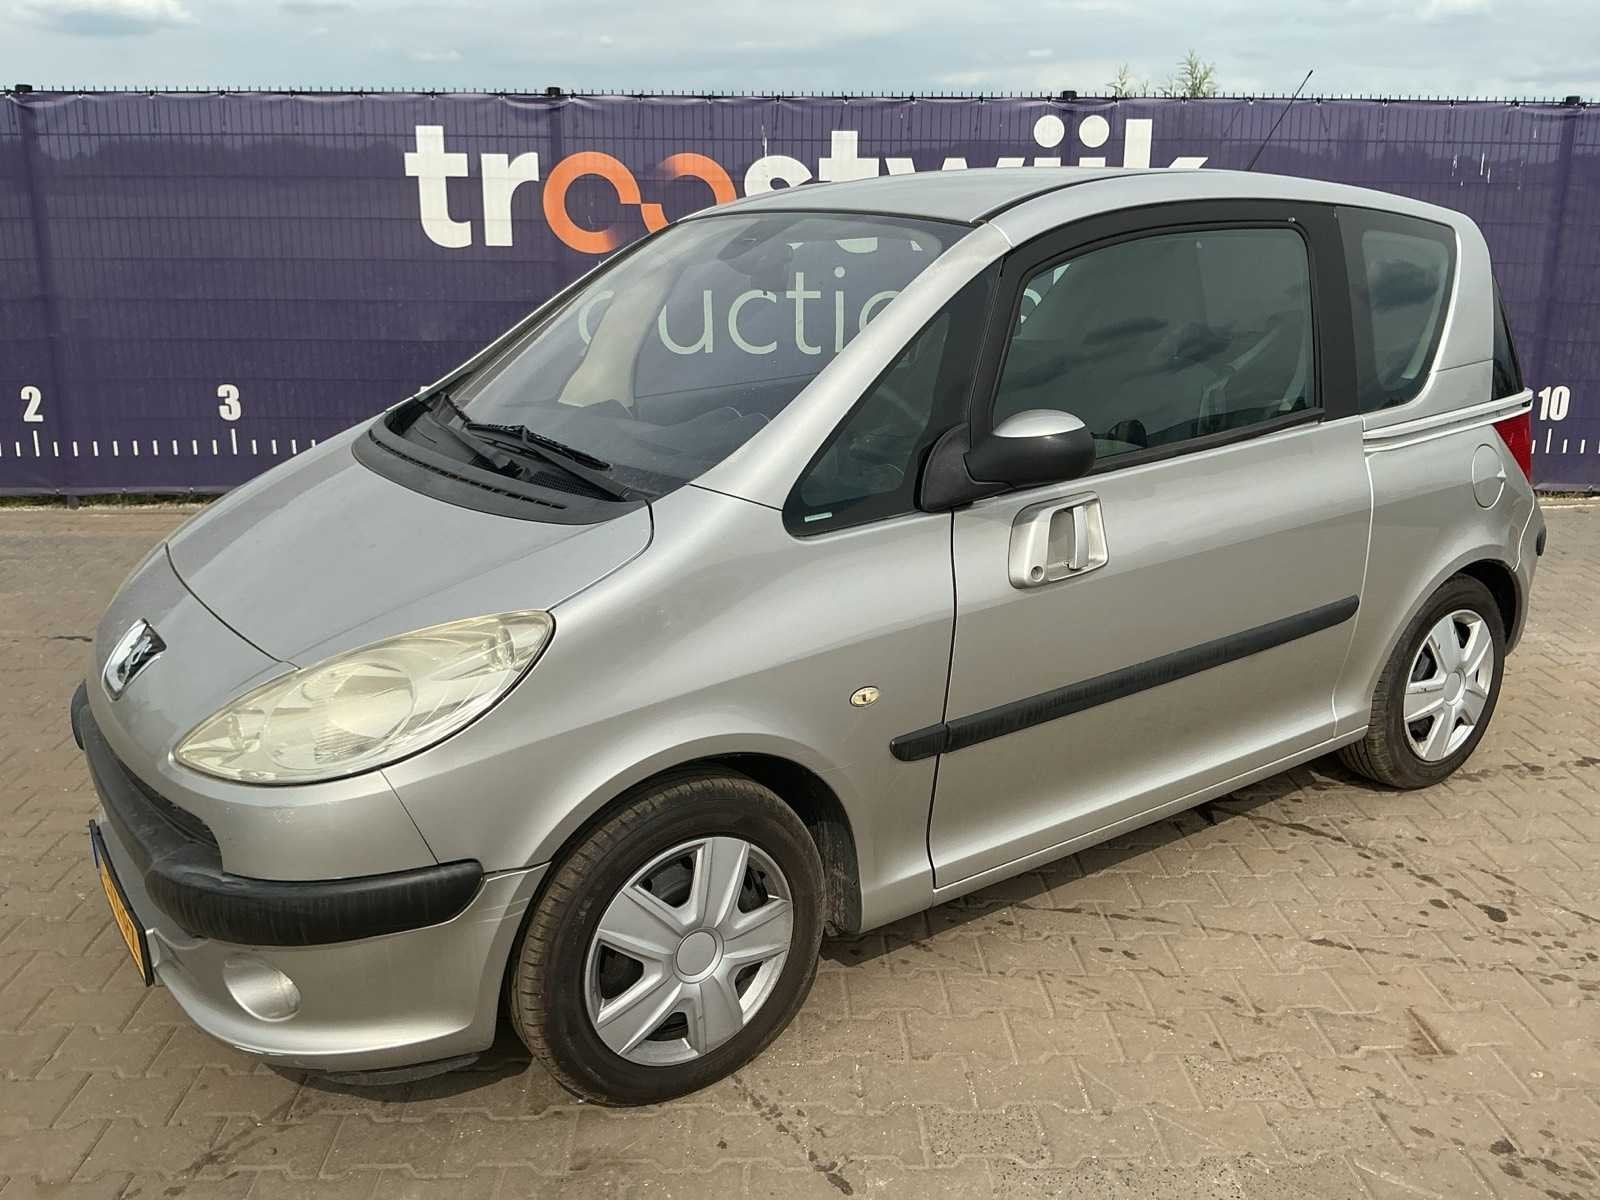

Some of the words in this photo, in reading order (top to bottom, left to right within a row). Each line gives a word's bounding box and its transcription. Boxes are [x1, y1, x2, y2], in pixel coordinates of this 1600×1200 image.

[20, 386, 44, 422] 2
[217, 383, 242, 421] 3
[1538, 385, 1571, 421] 10
